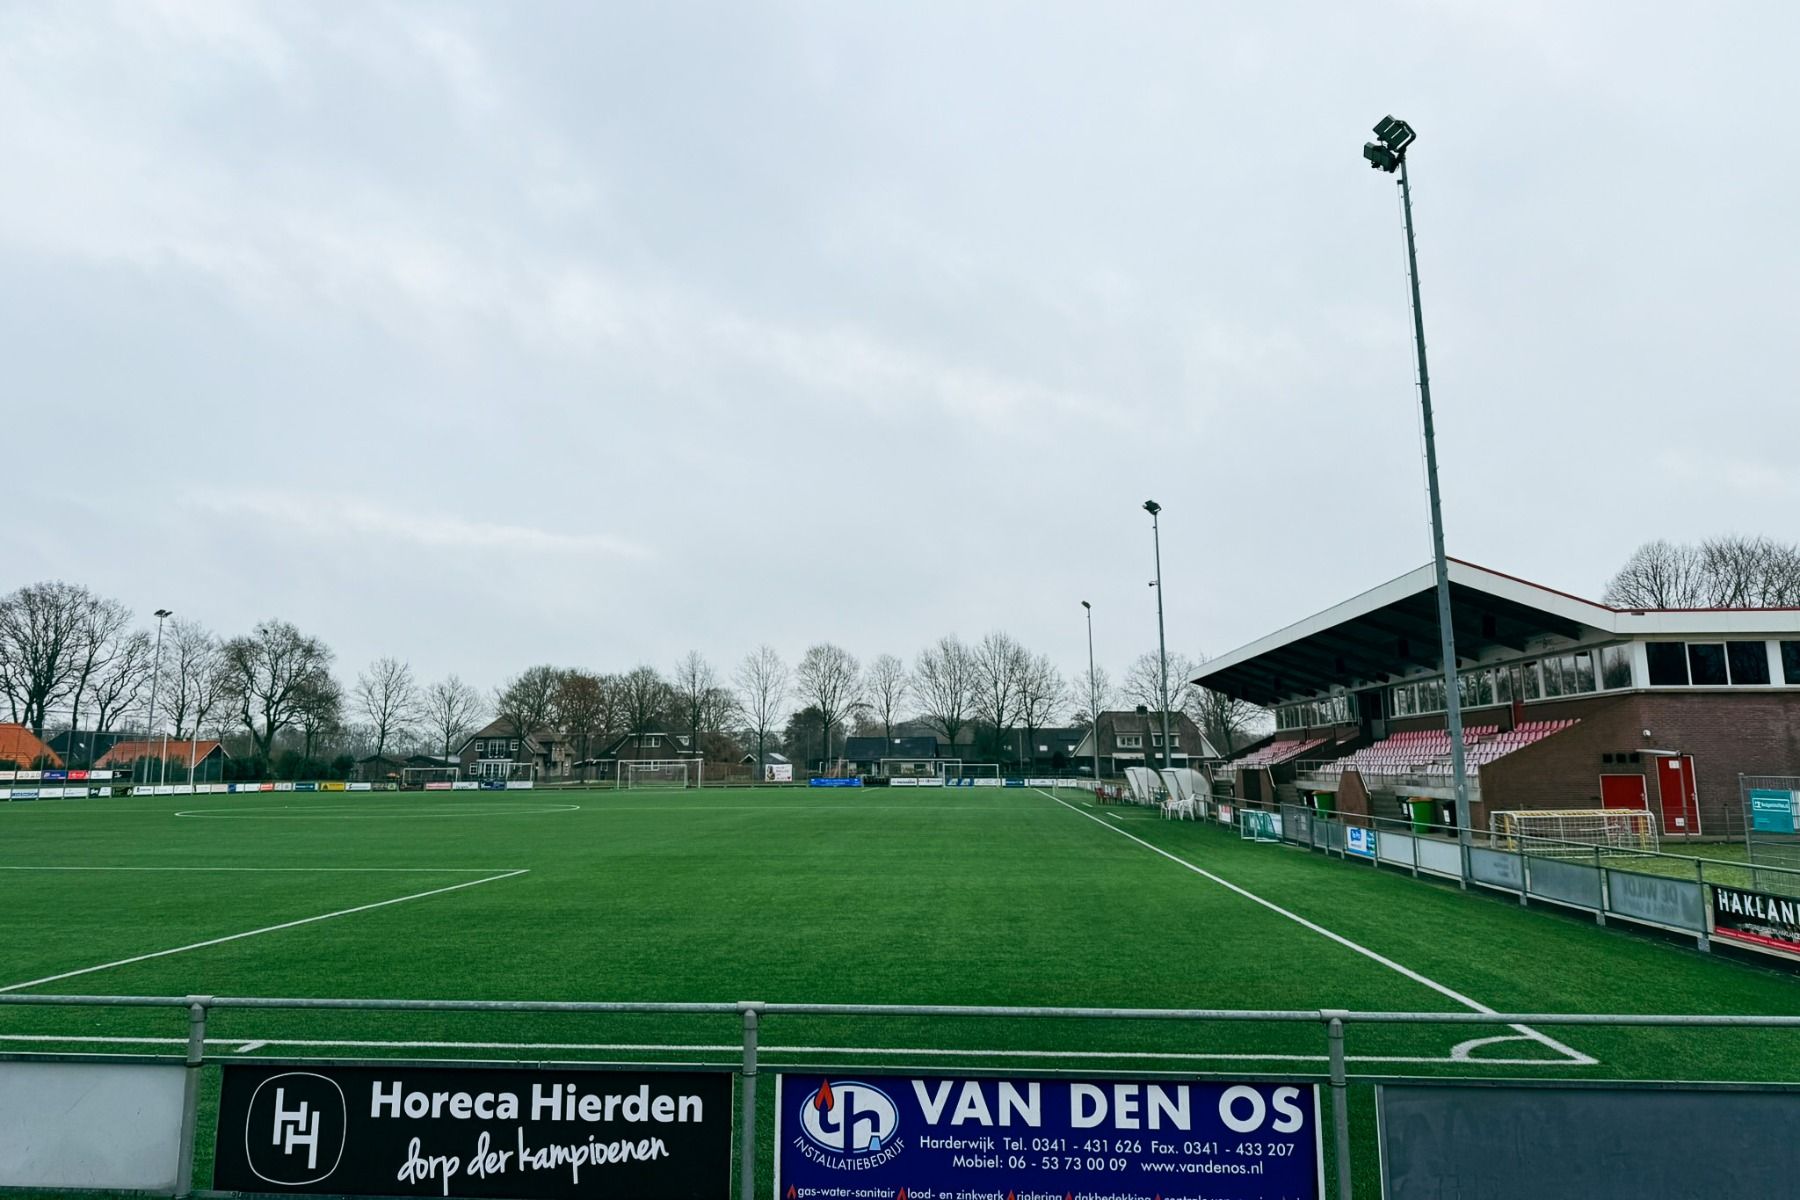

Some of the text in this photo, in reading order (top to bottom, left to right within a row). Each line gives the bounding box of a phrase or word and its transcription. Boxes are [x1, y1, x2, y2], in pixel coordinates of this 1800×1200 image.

[1717, 888, 1800, 926] HAKLAN
[371, 1081, 703, 1123] Horeca Hierden
[911, 1080, 1041, 1127] VAN
[1070, 1083, 1191, 1130] DEN
[1219, 1085, 1303, 1133] OS
[397, 1126, 669, 1196] dorp der kampioenen
[793, 1136, 905, 1170] INSTALLATIEBEDRIJF
[920, 1136, 995, 1153] Harderwijk
[1003, 1137, 1027, 1151] Tel.
[1032, 1138, 1066, 1152] 0341
[1083, 1139, 1109, 1152] 431
[1115, 1140, 1142, 1153] 626
[1151, 1141, 1179, 1154] Fax.
[1184, 1142, 1218, 1155] 0341
[1236, 1143, 1263, 1156] 433
[1267, 1143, 1295, 1156] 207
[952, 1154, 1003, 1169] Mobiel:
[1008, 1155, 1027, 1169] 06
[1041, 1156, 1059, 1170] 53
[1064, 1157, 1082, 1170] 73
[1086, 1158, 1105, 1171] 00
[1109, 1158, 1127, 1171] 09
[1140, 1160, 1264, 1175] www.vandenos.nl
[797, 1187, 896, 1198] gas-water-sanitair
[907, 1187, 936, 1200] lood-
[939, 1192, 953, 1200] en
[956, 1189, 1004, 1200] zinkwerk
